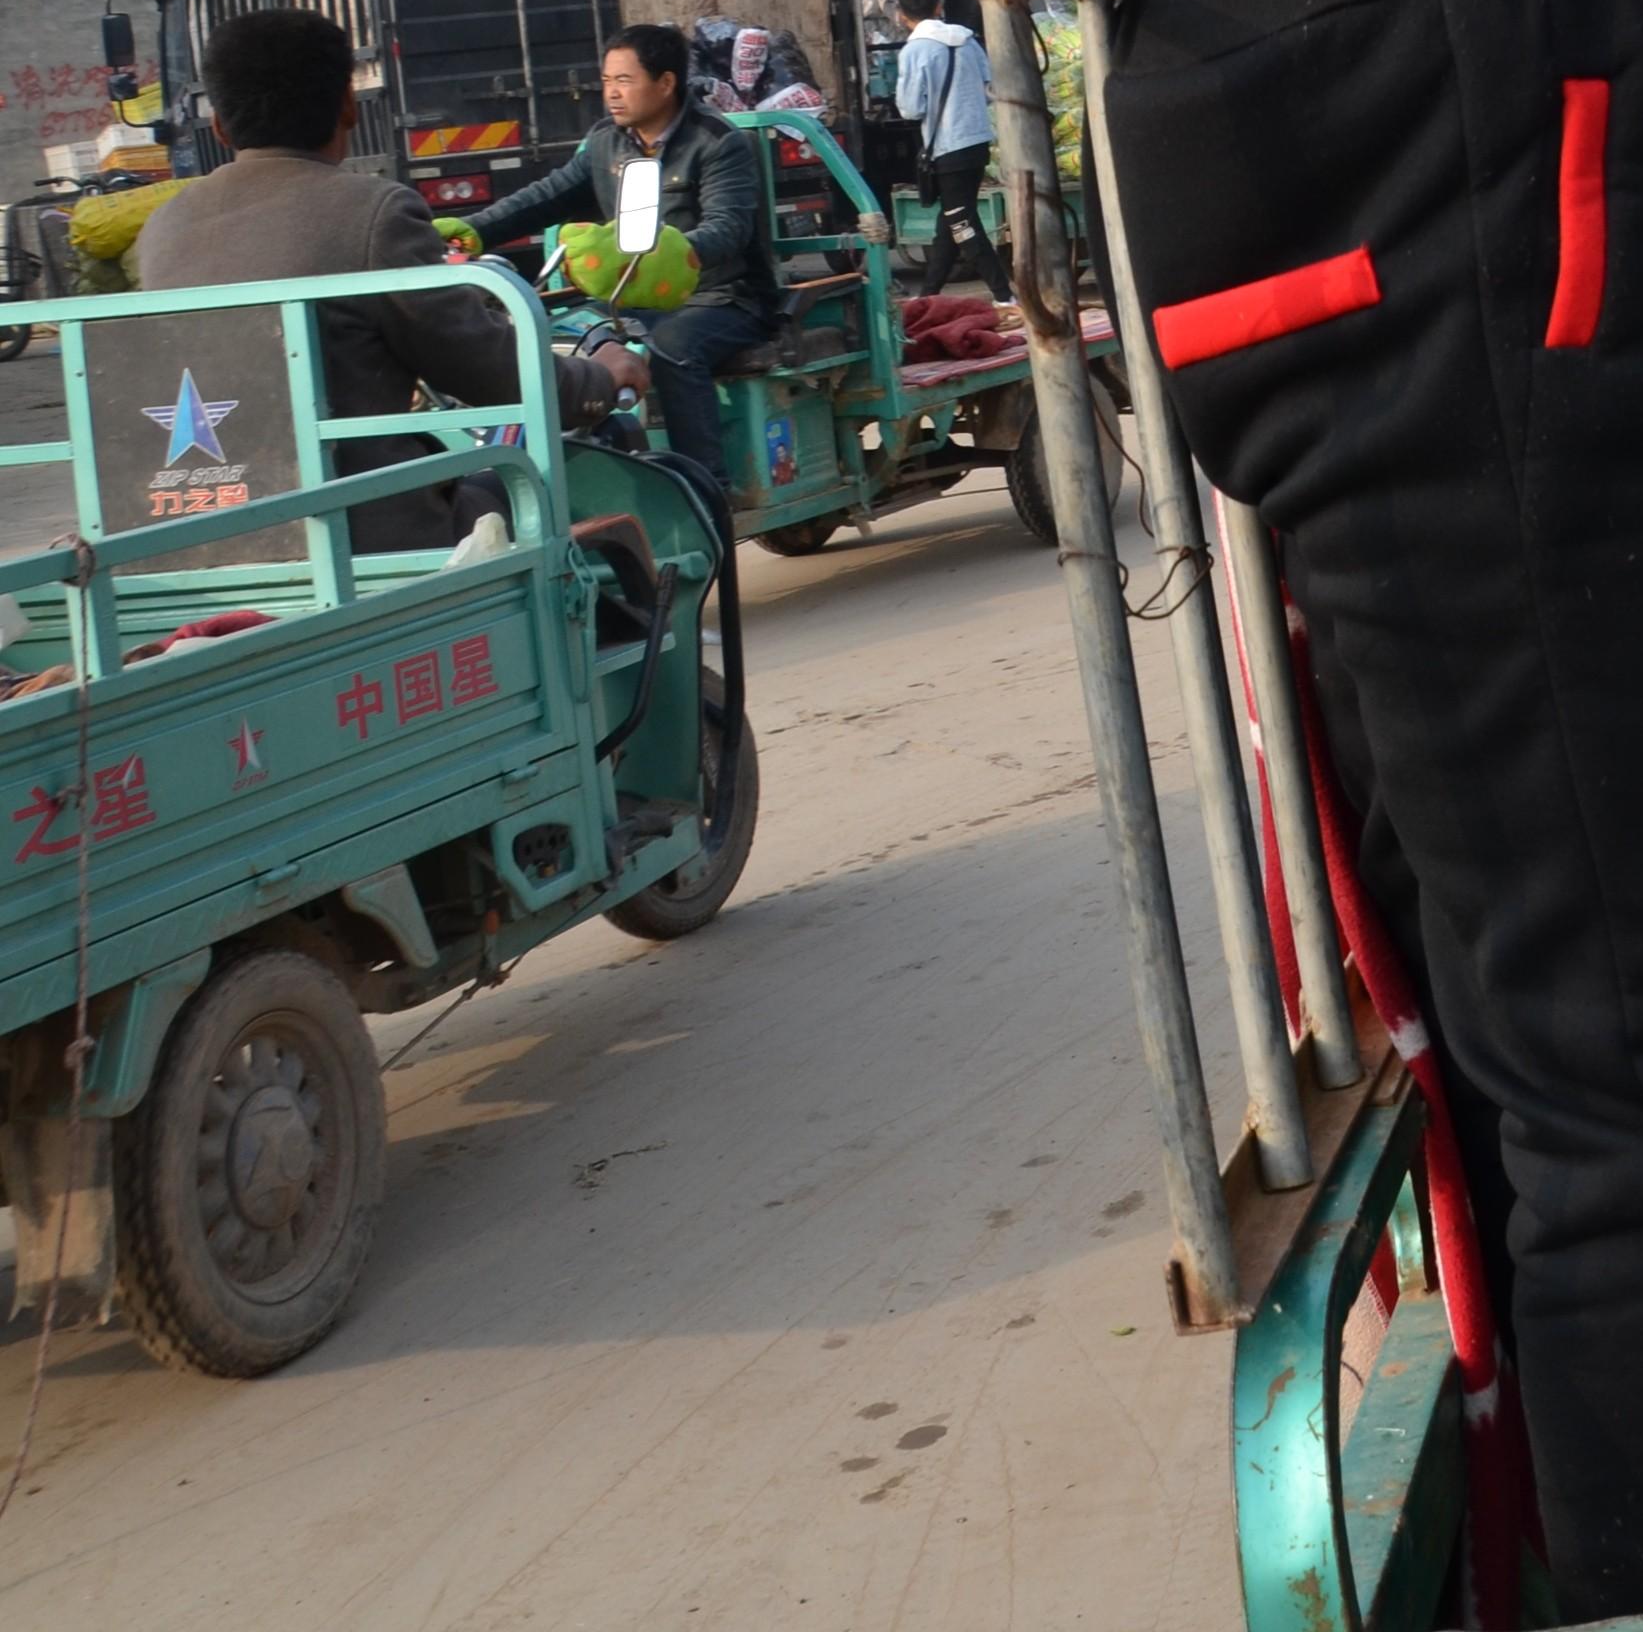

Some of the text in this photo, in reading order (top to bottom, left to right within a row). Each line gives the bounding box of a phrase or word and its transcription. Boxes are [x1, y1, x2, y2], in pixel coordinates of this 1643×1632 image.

[148, 464, 248, 488] ZIP STAR
[336, 634, 499, 741] 中国星
[11, 753, 157, 864] 之星
